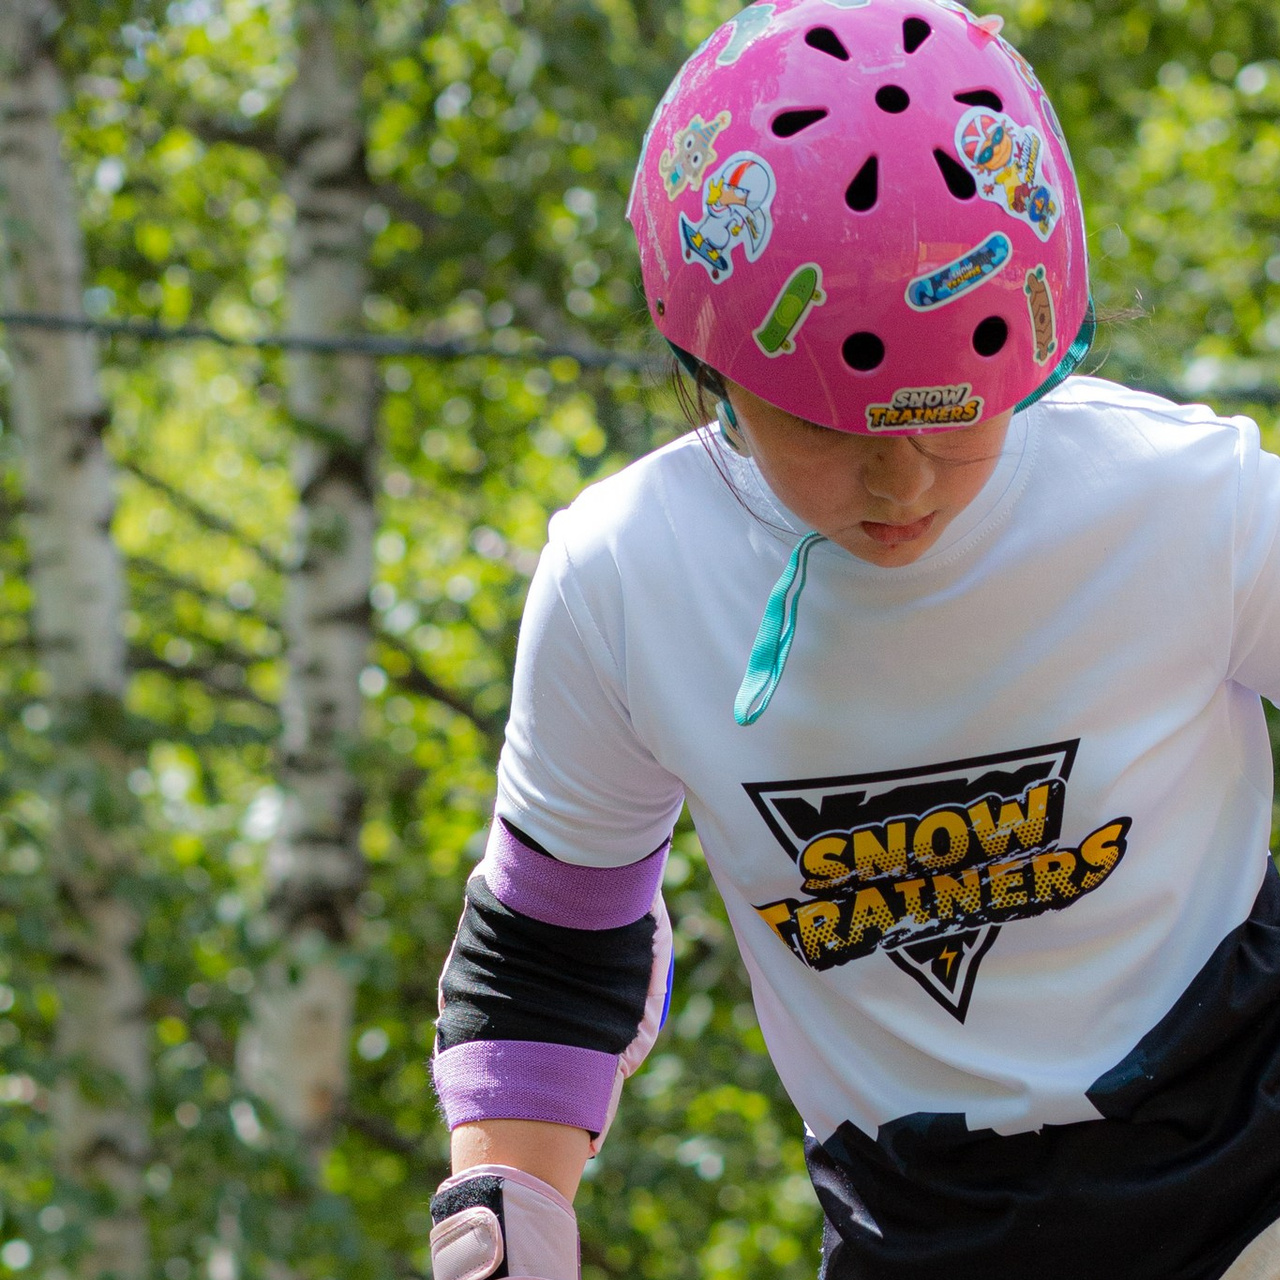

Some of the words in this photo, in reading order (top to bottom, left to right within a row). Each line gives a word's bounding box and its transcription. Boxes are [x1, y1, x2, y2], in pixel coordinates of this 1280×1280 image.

[893, 387, 968, 409] SNOW
[869, 400, 980, 427] TRAINERS
[803, 784, 1050, 891] SNOW
